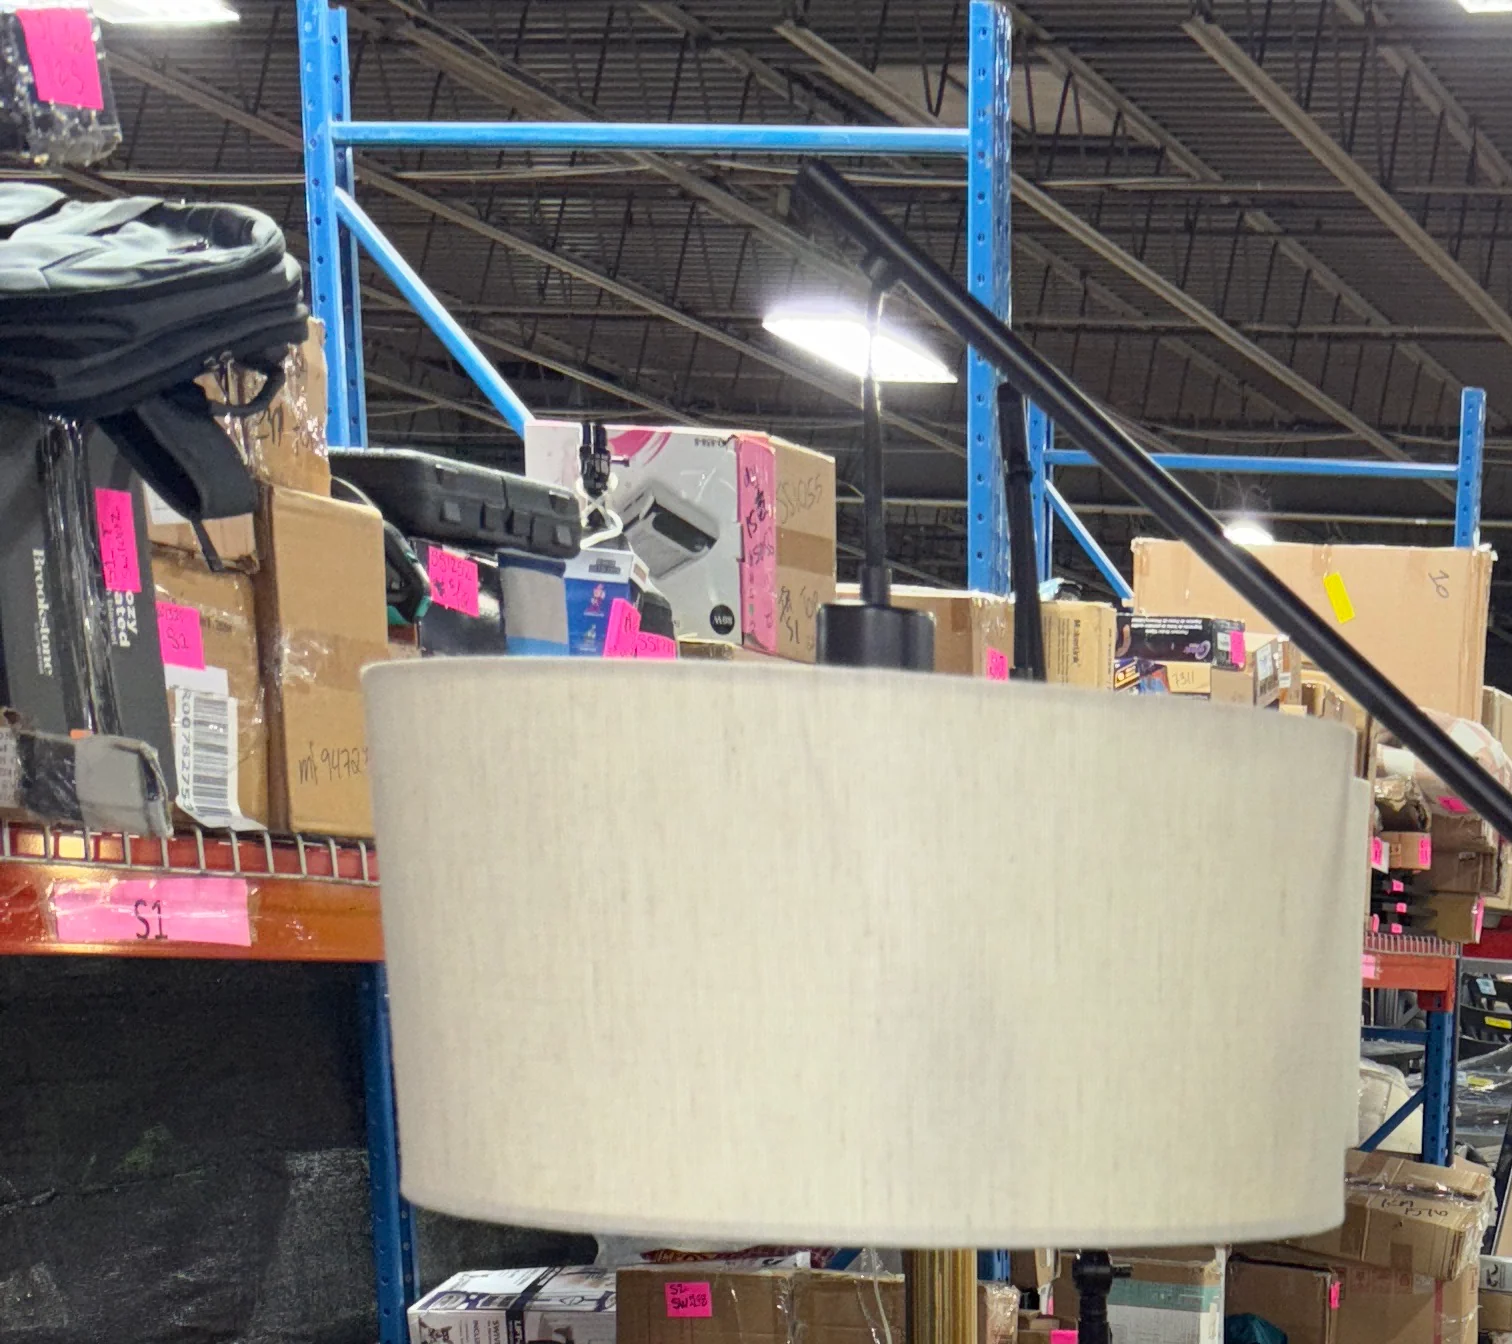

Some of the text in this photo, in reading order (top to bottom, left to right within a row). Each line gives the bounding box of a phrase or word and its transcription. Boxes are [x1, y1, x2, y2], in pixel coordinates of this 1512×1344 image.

[32, 548, 53, 677] Brookstone
[114, 589, 131, 648] ated
[125, 588, 139, 635] ozy
[135, 899, 169, 941] S1
